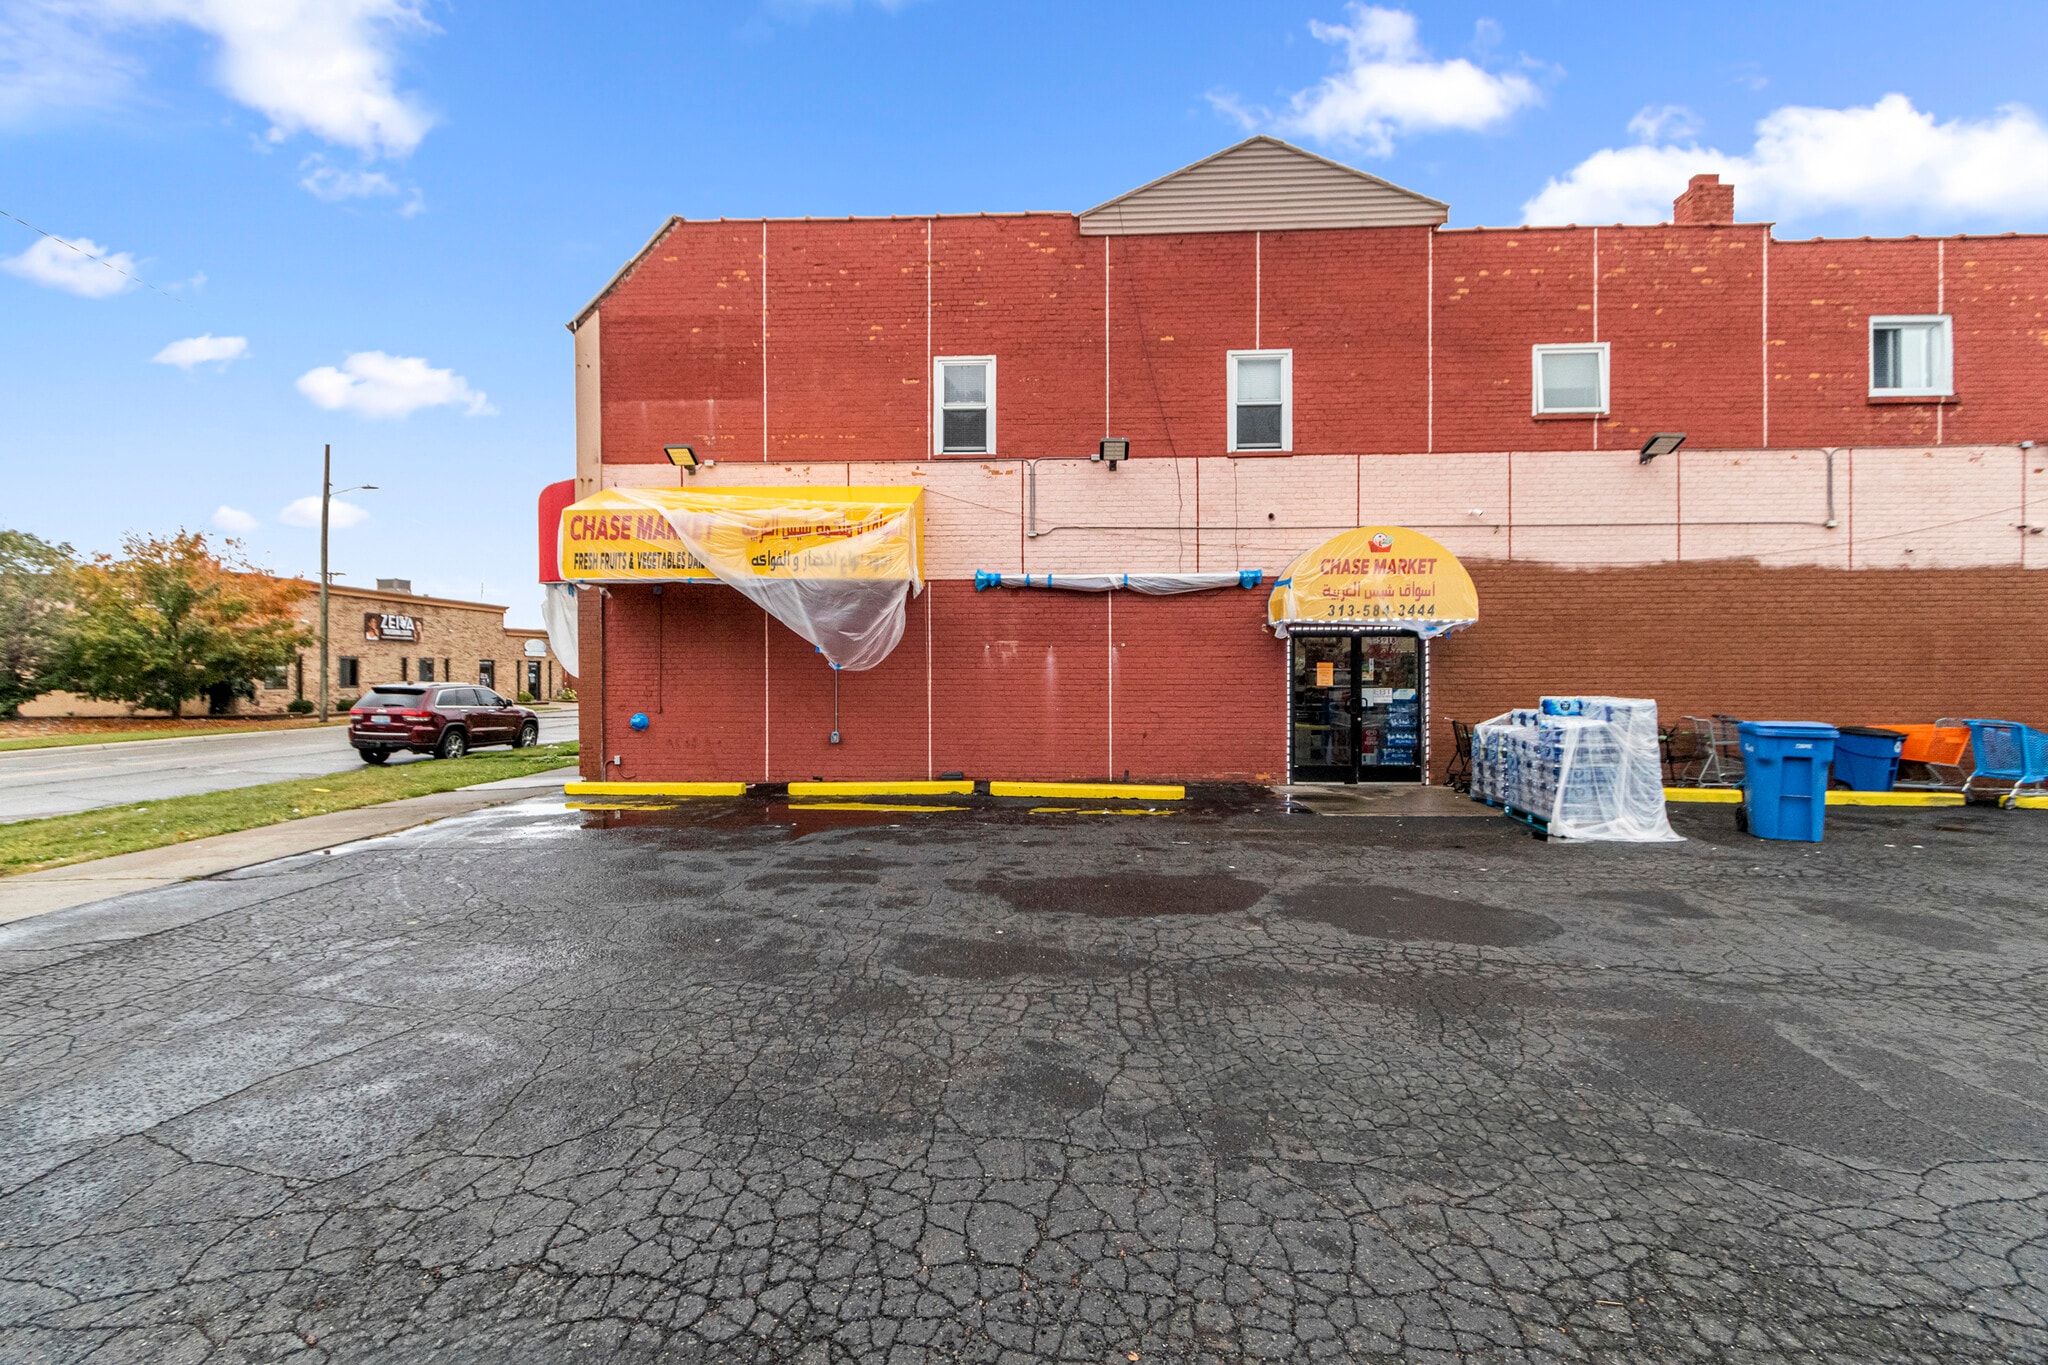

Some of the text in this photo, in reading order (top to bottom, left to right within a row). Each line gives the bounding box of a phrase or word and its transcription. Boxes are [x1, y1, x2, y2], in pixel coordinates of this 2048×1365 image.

[570, 514, 716, 541] CHASE MARET
[574, 551, 708, 570] FRESH FRUITS & VEGETABLES DAIL
[1320, 558, 1438, 575] CHASE MARKET
[1327, 604, 1435, 617] 313-584-3444
